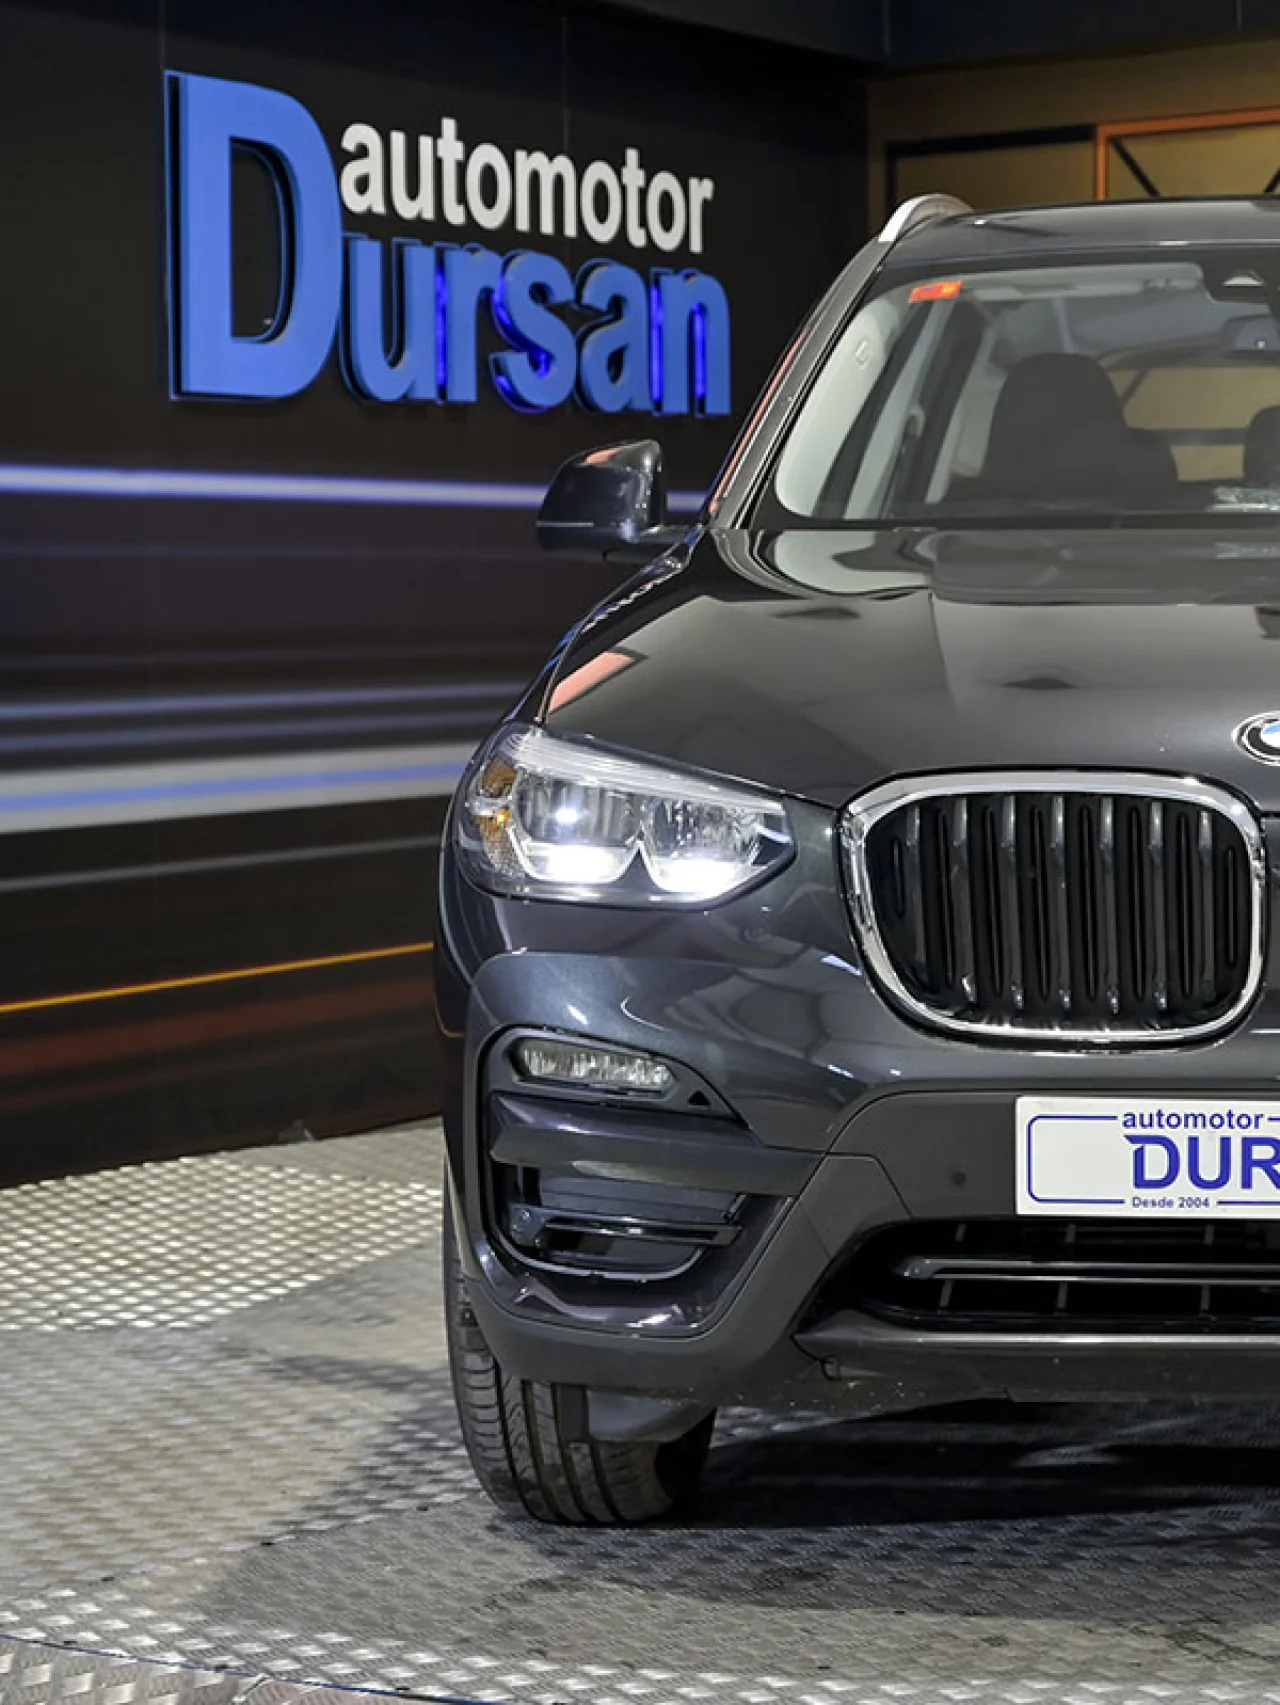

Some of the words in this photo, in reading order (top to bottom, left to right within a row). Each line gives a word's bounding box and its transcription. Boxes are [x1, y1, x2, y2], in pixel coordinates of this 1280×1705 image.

[340, 117, 715, 254] automotor
[163, 69, 731, 415] Dursan
[1122, 1109, 1264, 1130] automotor
[1132, 1196, 1174, 1208] Desde
[1179, 1197, 1210, 1209] 2004
